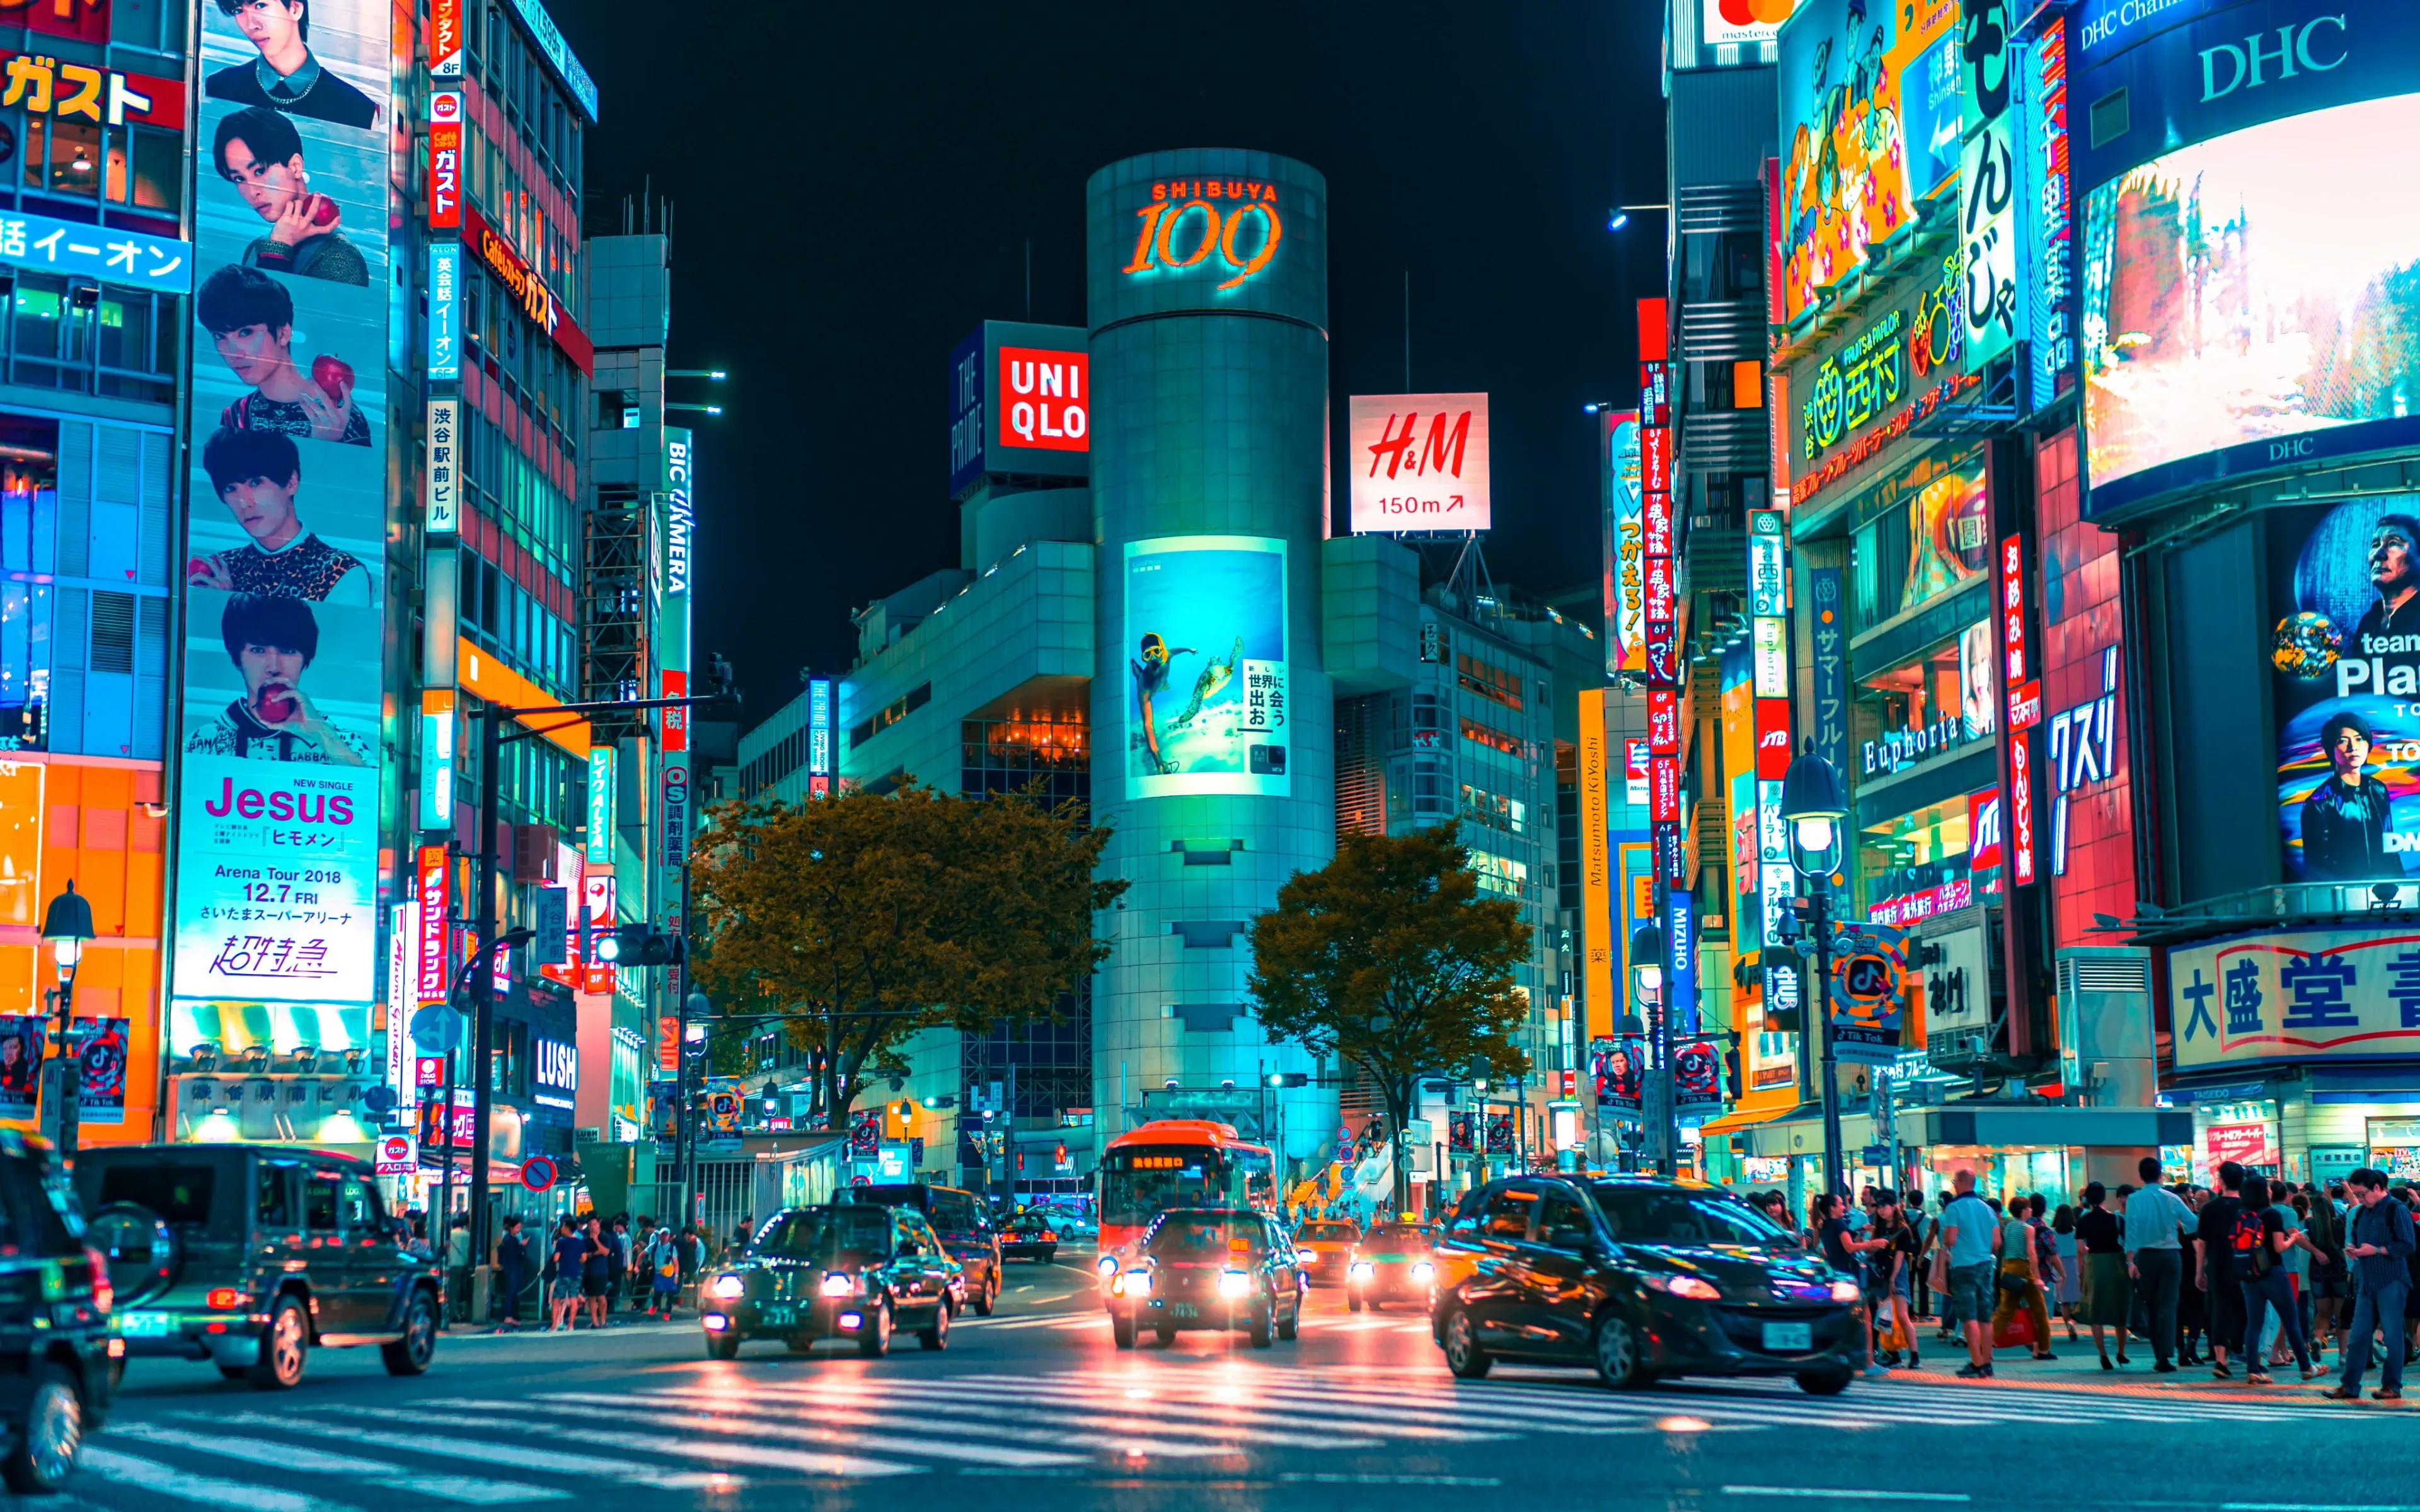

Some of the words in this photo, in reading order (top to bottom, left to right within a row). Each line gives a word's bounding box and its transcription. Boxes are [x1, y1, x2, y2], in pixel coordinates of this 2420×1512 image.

[2082, 10, 2118, 52] DHC
[442, 62, 459, 74] 8F
[2198, 13, 2348, 103] DHC
[3, 55, 151, 126] ガスト
[434, 131, 457, 141] Café
[435, 149, 456, 215] ガスト
[1153, 181, 1277, 202] SHIBUYA
[1122, 200, 1282, 290] 109
[435, 257, 453, 366] 英会話イーオン
[524, 268, 558, 338] ガスト
[436, 369, 450, 379] 6F
[957, 350, 977, 404] THE
[1011, 360, 1080, 399] UNI
[1844, 336, 1901, 431] 西村
[951, 402, 982, 478] PRIME
[1011, 401, 1086, 442] QLO
[669, 442, 686, 482] BIC
[1368, 410, 1473, 480] H&M
[2269, 437, 2314, 461] DHC
[432, 408, 451, 522] 渋谷駅前ビル
[1378, 496, 1441, 515] 150m
[1651, 494, 1662, 503] 7F
[668, 488, 695, 594] CAMERA
[1132, 559, 1161, 568] GoPro
[1653, 559, 1664, 568] 7F
[1654, 626, 1666, 634] 6F
[1248, 665, 1284, 673] 新しい
[1766, 622, 1776, 684] Euphoria
[814, 683, 826, 698] THE
[1248, 674, 1284, 689] 世界に
[2336, 656, 2420, 697] Pla
[814, 701, 826, 726] PRIME
[1656, 693, 1667, 702] 6F
[1817, 629, 1843, 793] サマーフルー
[1760, 730, 1787, 748] JTB
[1863, 714, 1959, 776] Euphoria
[1586, 736, 1599, 793] KiYoshi
[1657, 759, 1670, 769] 6F
[205, 777, 354, 825] Jesus
[293, 779, 316, 789] NEW
[318, 780, 354, 791] SINGLE
[666, 766, 688, 803] OS
[667, 805, 683, 868] 調剤薬局
[1589, 796, 1602, 887] Matsumoto
[214, 864, 261, 880] Arena
[267, 867, 300, 882] Tour
[304, 869, 342, 883] 2018
[243, 883, 291, 903] 12.7
[295, 892, 318, 905] FRI
[1767, 886, 1778, 928] フルーツ
[1902, 895, 1932, 920] 海外旅行
[200, 906, 353, 925] さいたまスーパーアリーナ
[540, 903, 548, 934] Shibuya
[549, 894, 564, 958] 渋谷駅前
[208, 935, 338, 978] 超特急
[423, 892, 442, 989] サンドラッグ
[1590, 948, 1607, 963] 薬
[1673, 907, 1688, 971] MIZUHO
[590, 974, 603, 983] 3F
[1766, 967, 1774, 996] BRITISH
[1773, 965, 1798, 1011] HUB
[1847, 1030, 1862, 1041] Tik
[1864, 1032, 1883, 1043] Tok
[537, 1039, 577, 1091] LUSH
[192, 1084, 366, 1103] 渋谷駅前ビル
[2193, 1089, 2229, 1099] TAISEIDO
[387, 1145, 407, 1155] ガスト
